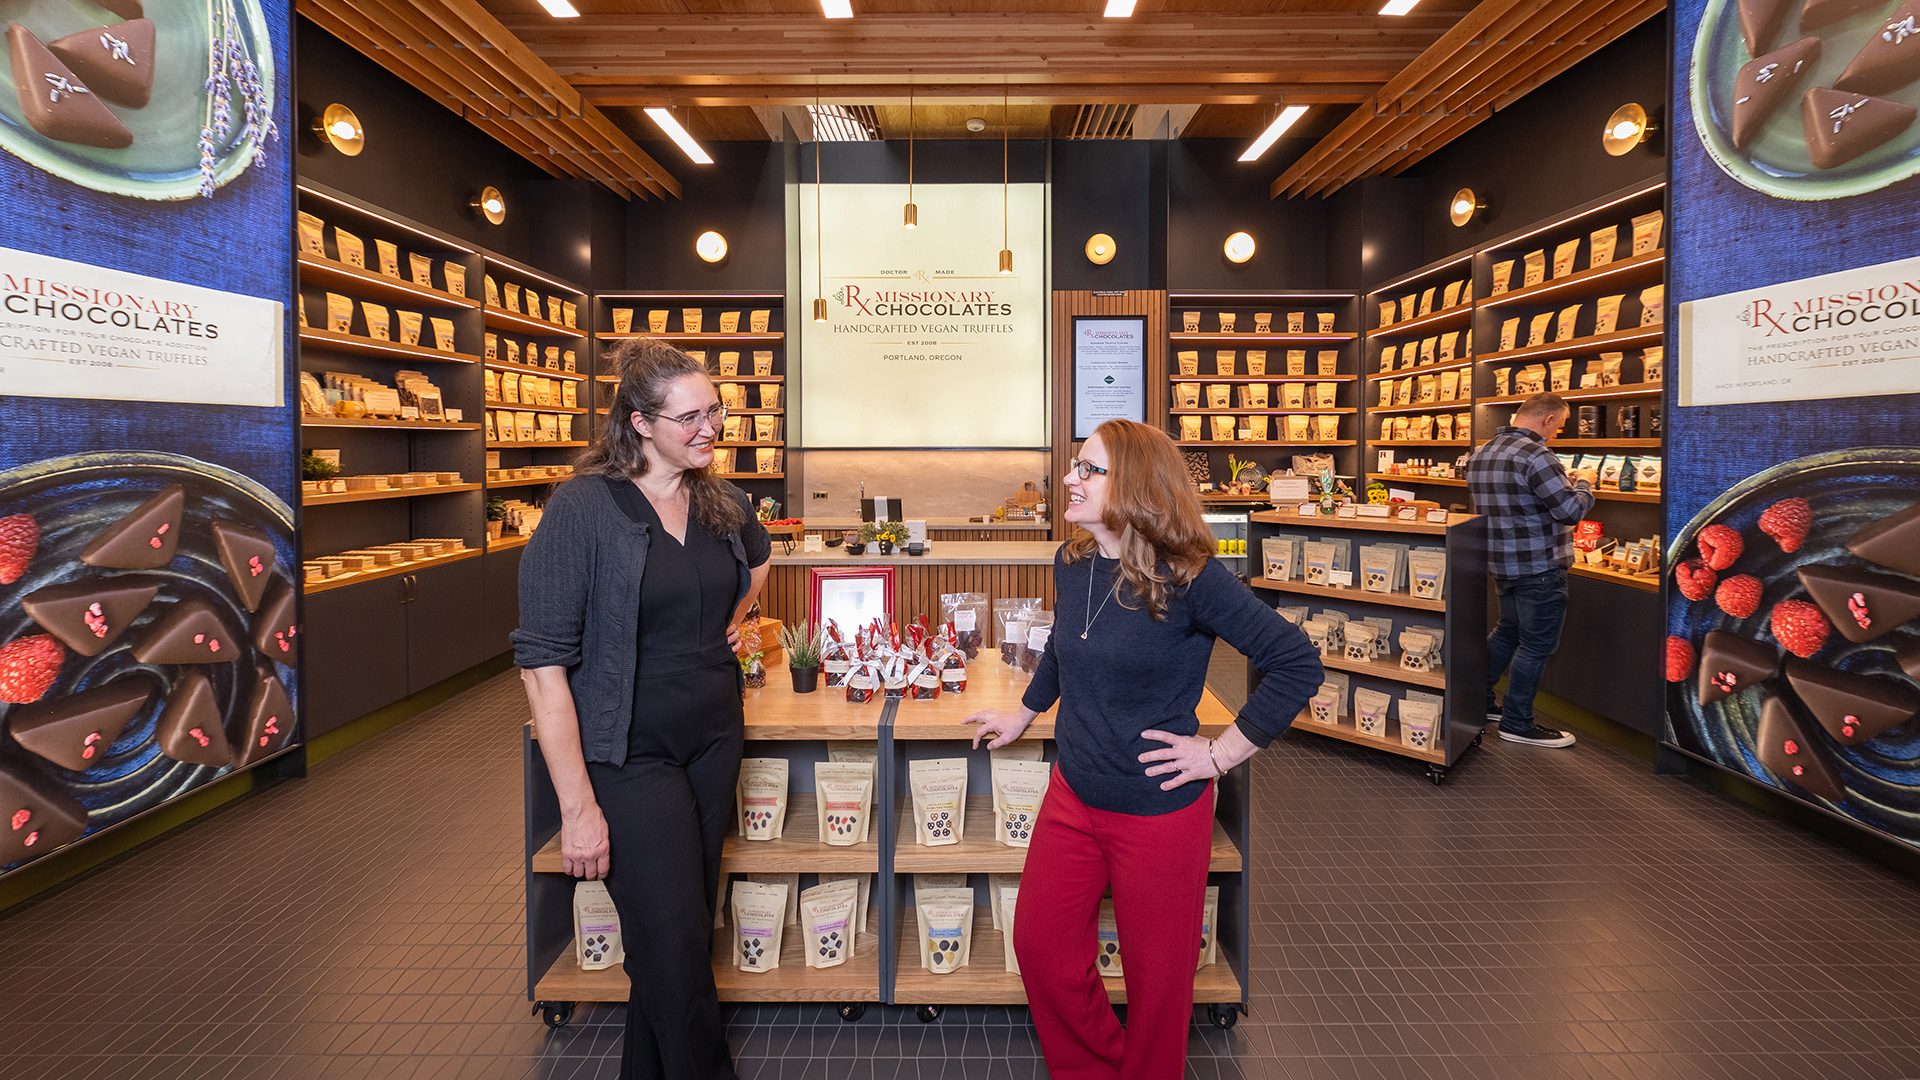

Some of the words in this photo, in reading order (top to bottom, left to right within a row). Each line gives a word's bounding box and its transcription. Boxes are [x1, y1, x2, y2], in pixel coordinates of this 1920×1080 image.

[2, 273, 198, 319] MISSIONARY
[875, 291, 996, 303] MISSIONARY
[1791, 279, 1920, 316] MISSION
[5, 294, 219, 339] CHOCOLATES
[875, 303, 1012, 316] CHOCOLATES
[56, 328, 76, 337] FOR
[80, 331, 107, 340] YOUR
[109, 334, 162, 347] CHOCOLATE
[165, 341, 207, 351] ADDICTION
[834, 324, 918, 334] HANDCRAFTED
[921, 324, 959, 334] VEGAN
[962, 324, 1014, 334] TRUFFLES
[1766, 337, 1827, 349] PRESCRIPTION
[1853, 330, 1879, 338] YOUR
[87, 343, 141, 359] VEGAN
[146, 350, 208, 366] TRUFFLES
[1748, 345, 1855, 366] HANDCRAFTED
[1859, 337, 1919, 353] VEGAN
[1861, 357, 1886, 365] 2008
